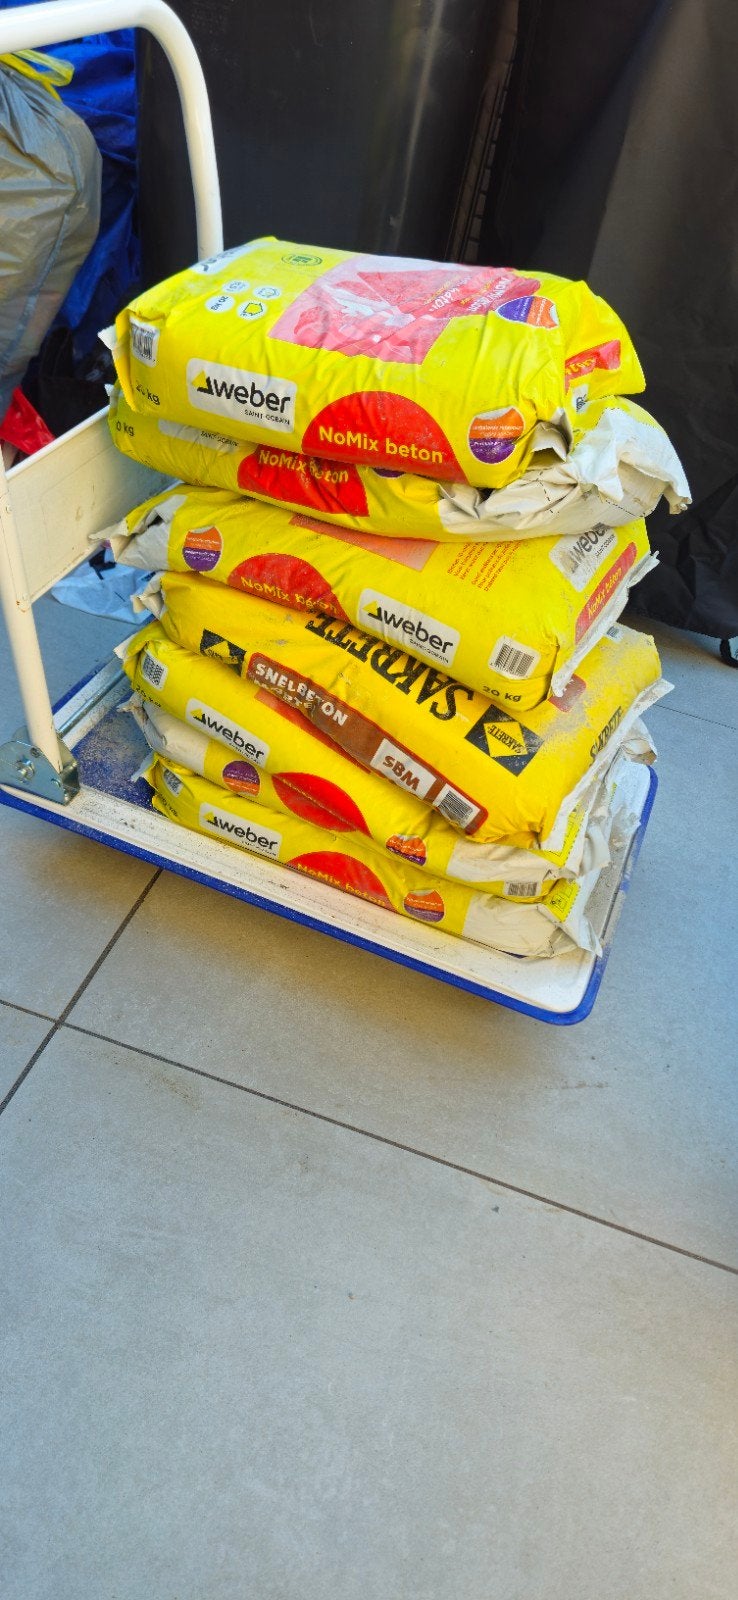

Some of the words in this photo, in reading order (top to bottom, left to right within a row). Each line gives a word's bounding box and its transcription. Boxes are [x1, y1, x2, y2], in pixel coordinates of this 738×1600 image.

[147, 390, 160, 405] kg
[213, 377, 291, 413] weber
[124, 426, 135, 437] kg
[319, 425, 379, 452] NoMix
[385, 437, 443, 464] beton
[258, 449, 307, 474] NoMix
[309, 457, 349, 484] beton
[241, 576, 290, 602] NoMix
[384, 609, 454, 653] weber
[305, 612, 475, 721] SAKRETE
[255, 663, 349, 726] SNELBETON
[483, 685, 500, 697] 20
[505, 692, 522, 702] kg
[207, 716, 265, 760] weber
[487, 724, 523, 754] SAKRETE
[382, 755, 420, 792] SBM
[219, 818, 278, 850] weber
